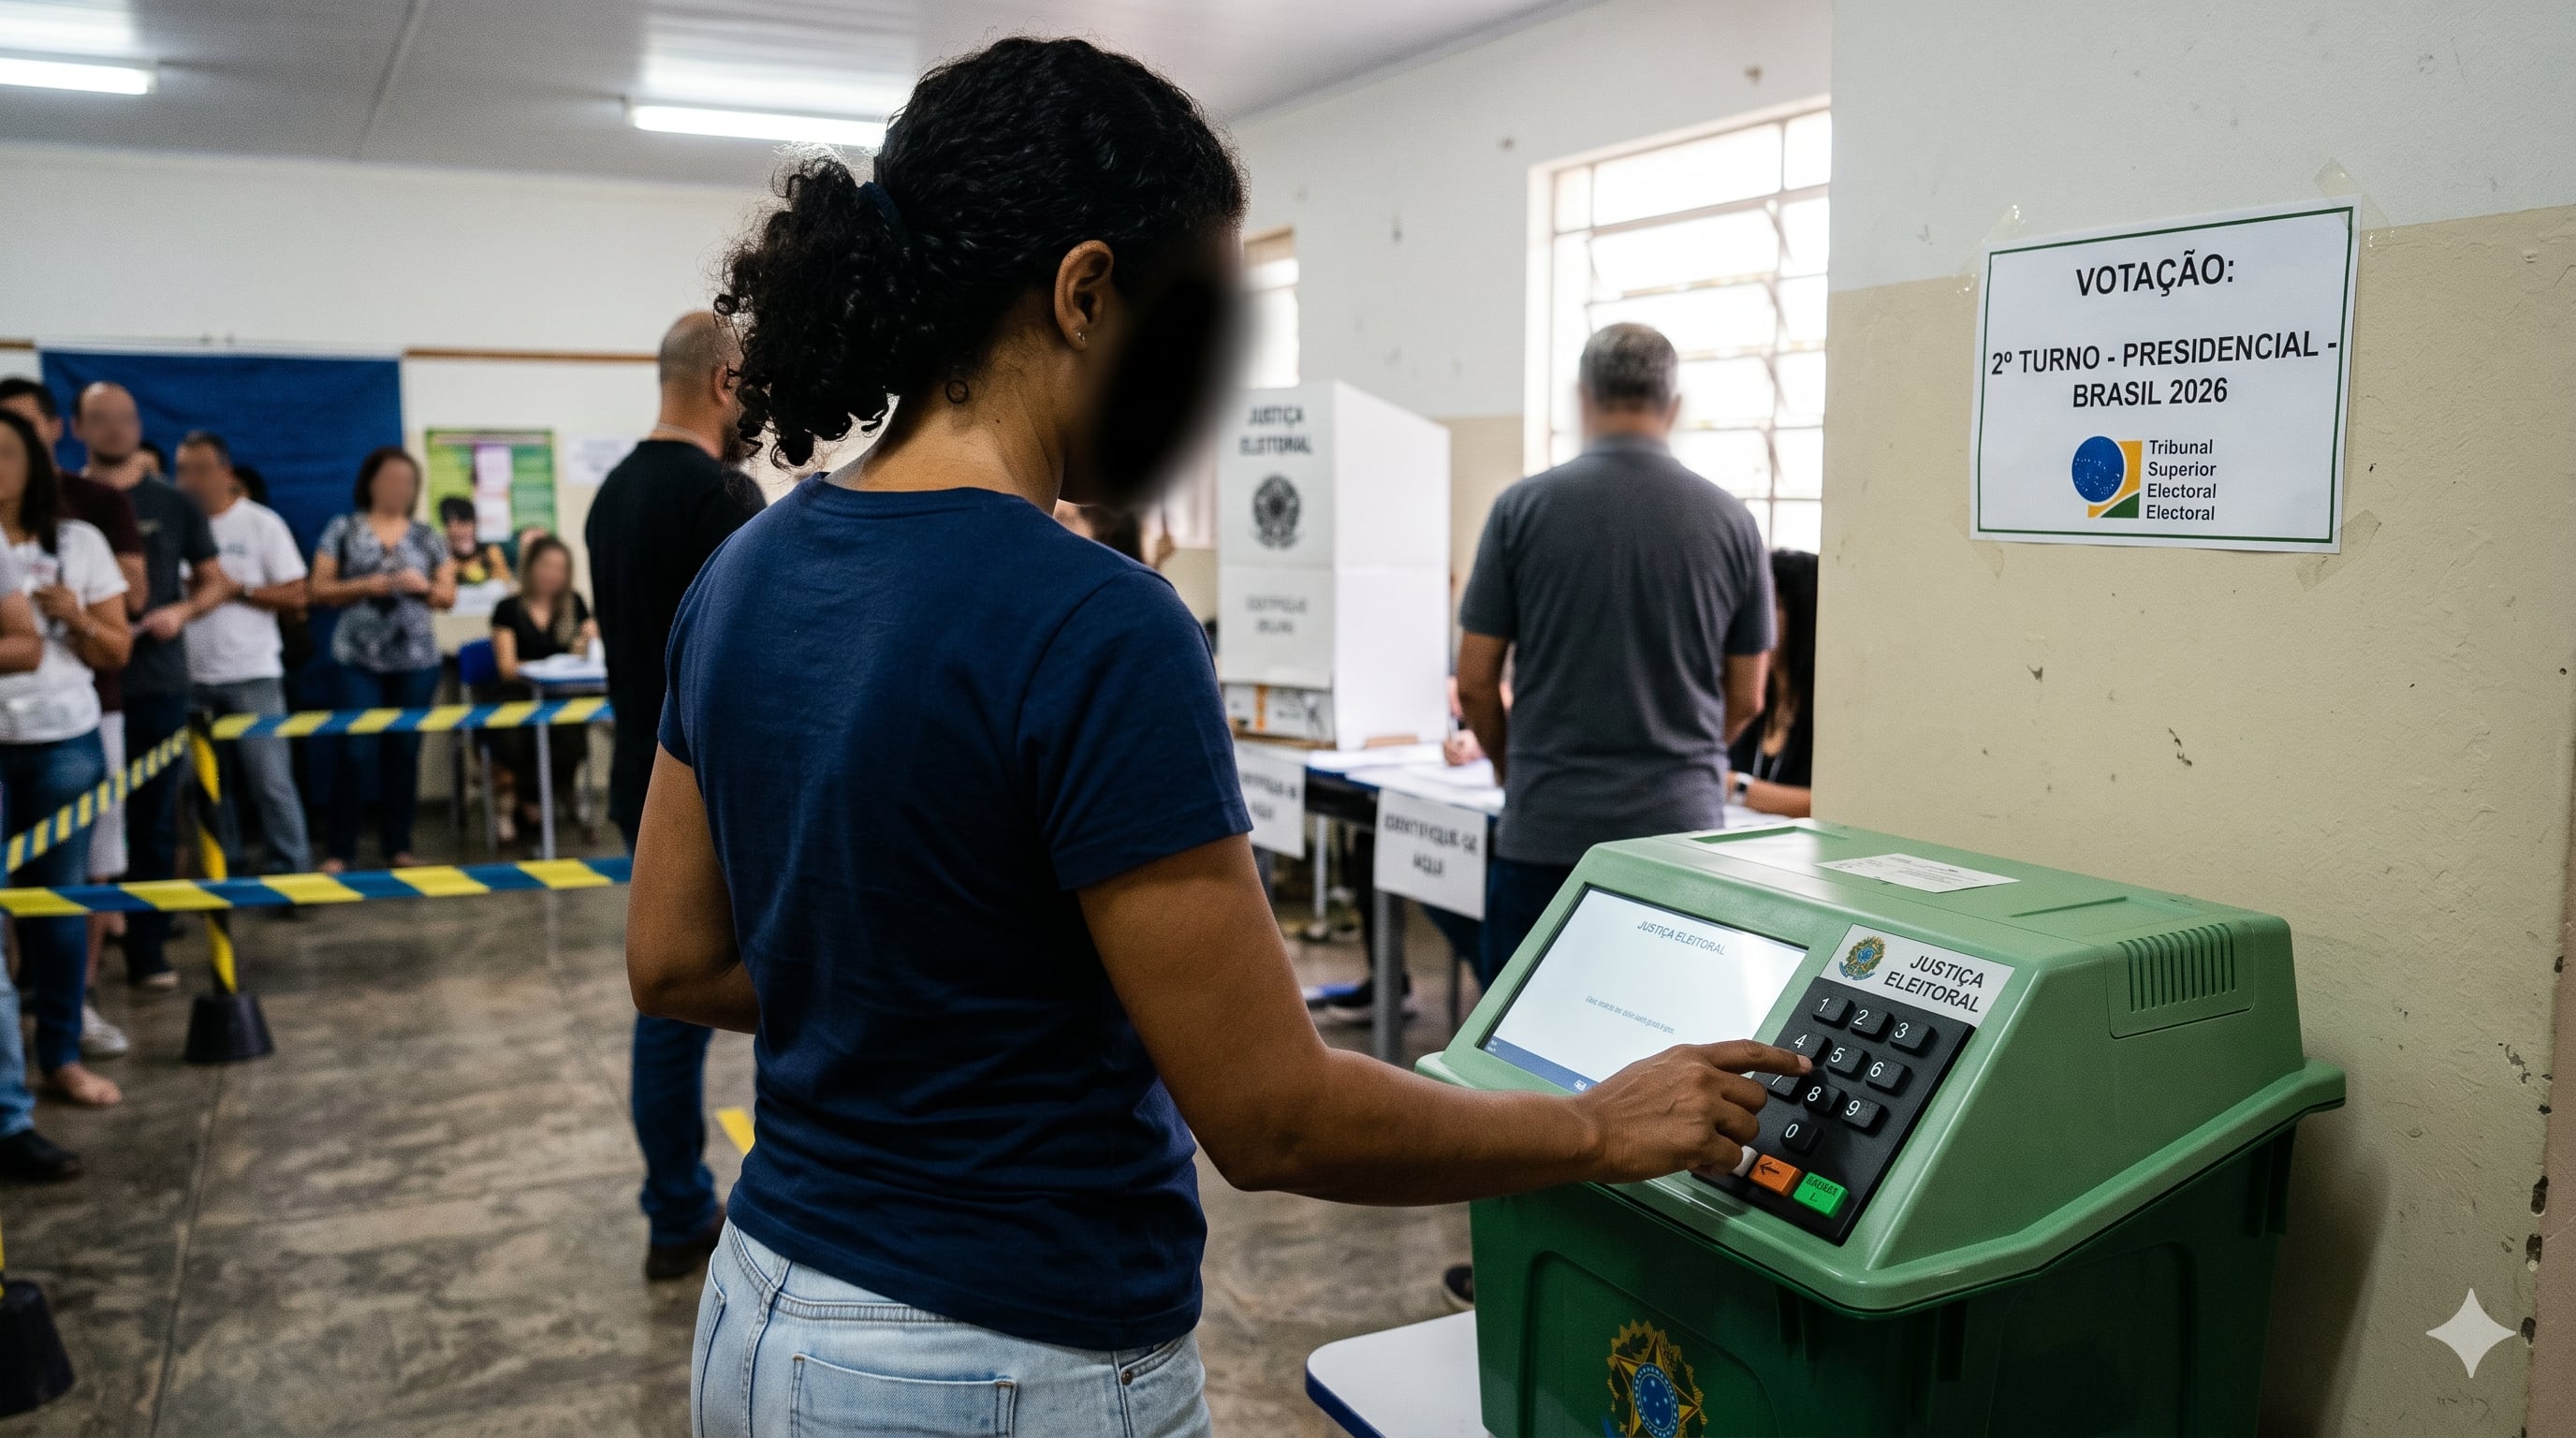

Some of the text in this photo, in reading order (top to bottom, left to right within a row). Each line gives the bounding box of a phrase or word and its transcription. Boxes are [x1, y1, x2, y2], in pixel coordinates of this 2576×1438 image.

[2075, 248, 2235, 298] VOTAÇÃO:
[1992, 351, 2012, 375] 2º
[2019, 345, 2100, 374] TURNO
[2123, 330, 2320, 368] PRESIDENCIAL
[2072, 376, 2228, 409] BRASIL 2026
[2148, 438, 2214, 456] Tribunal
[2147, 461, 2217, 480] Superior
[2147, 482, 2217, 500] Electoral
[2146, 504, 2216, 521] Electoral
[1637, 920, 1726, 956] JUSTIÇA ELEITORAL
[1910, 955, 1985, 989] JUSTIÇA
[1883, 972, 1980, 1013] ELEITORAL
[1819, 997, 1830, 1012] 1
[1853, 1009, 1869, 1026] 2
[1895, 1021, 1910, 1039] 3
[1793, 1034, 1807, 1049] 4
[1830, 1047, 1846, 1064] 5
[1869, 1061, 1884, 1078] 6
[1807, 1086, 1822, 1102] 8
[1845, 1099, 1861, 1117] 9
[1785, 1123, 1799, 1138] 0
